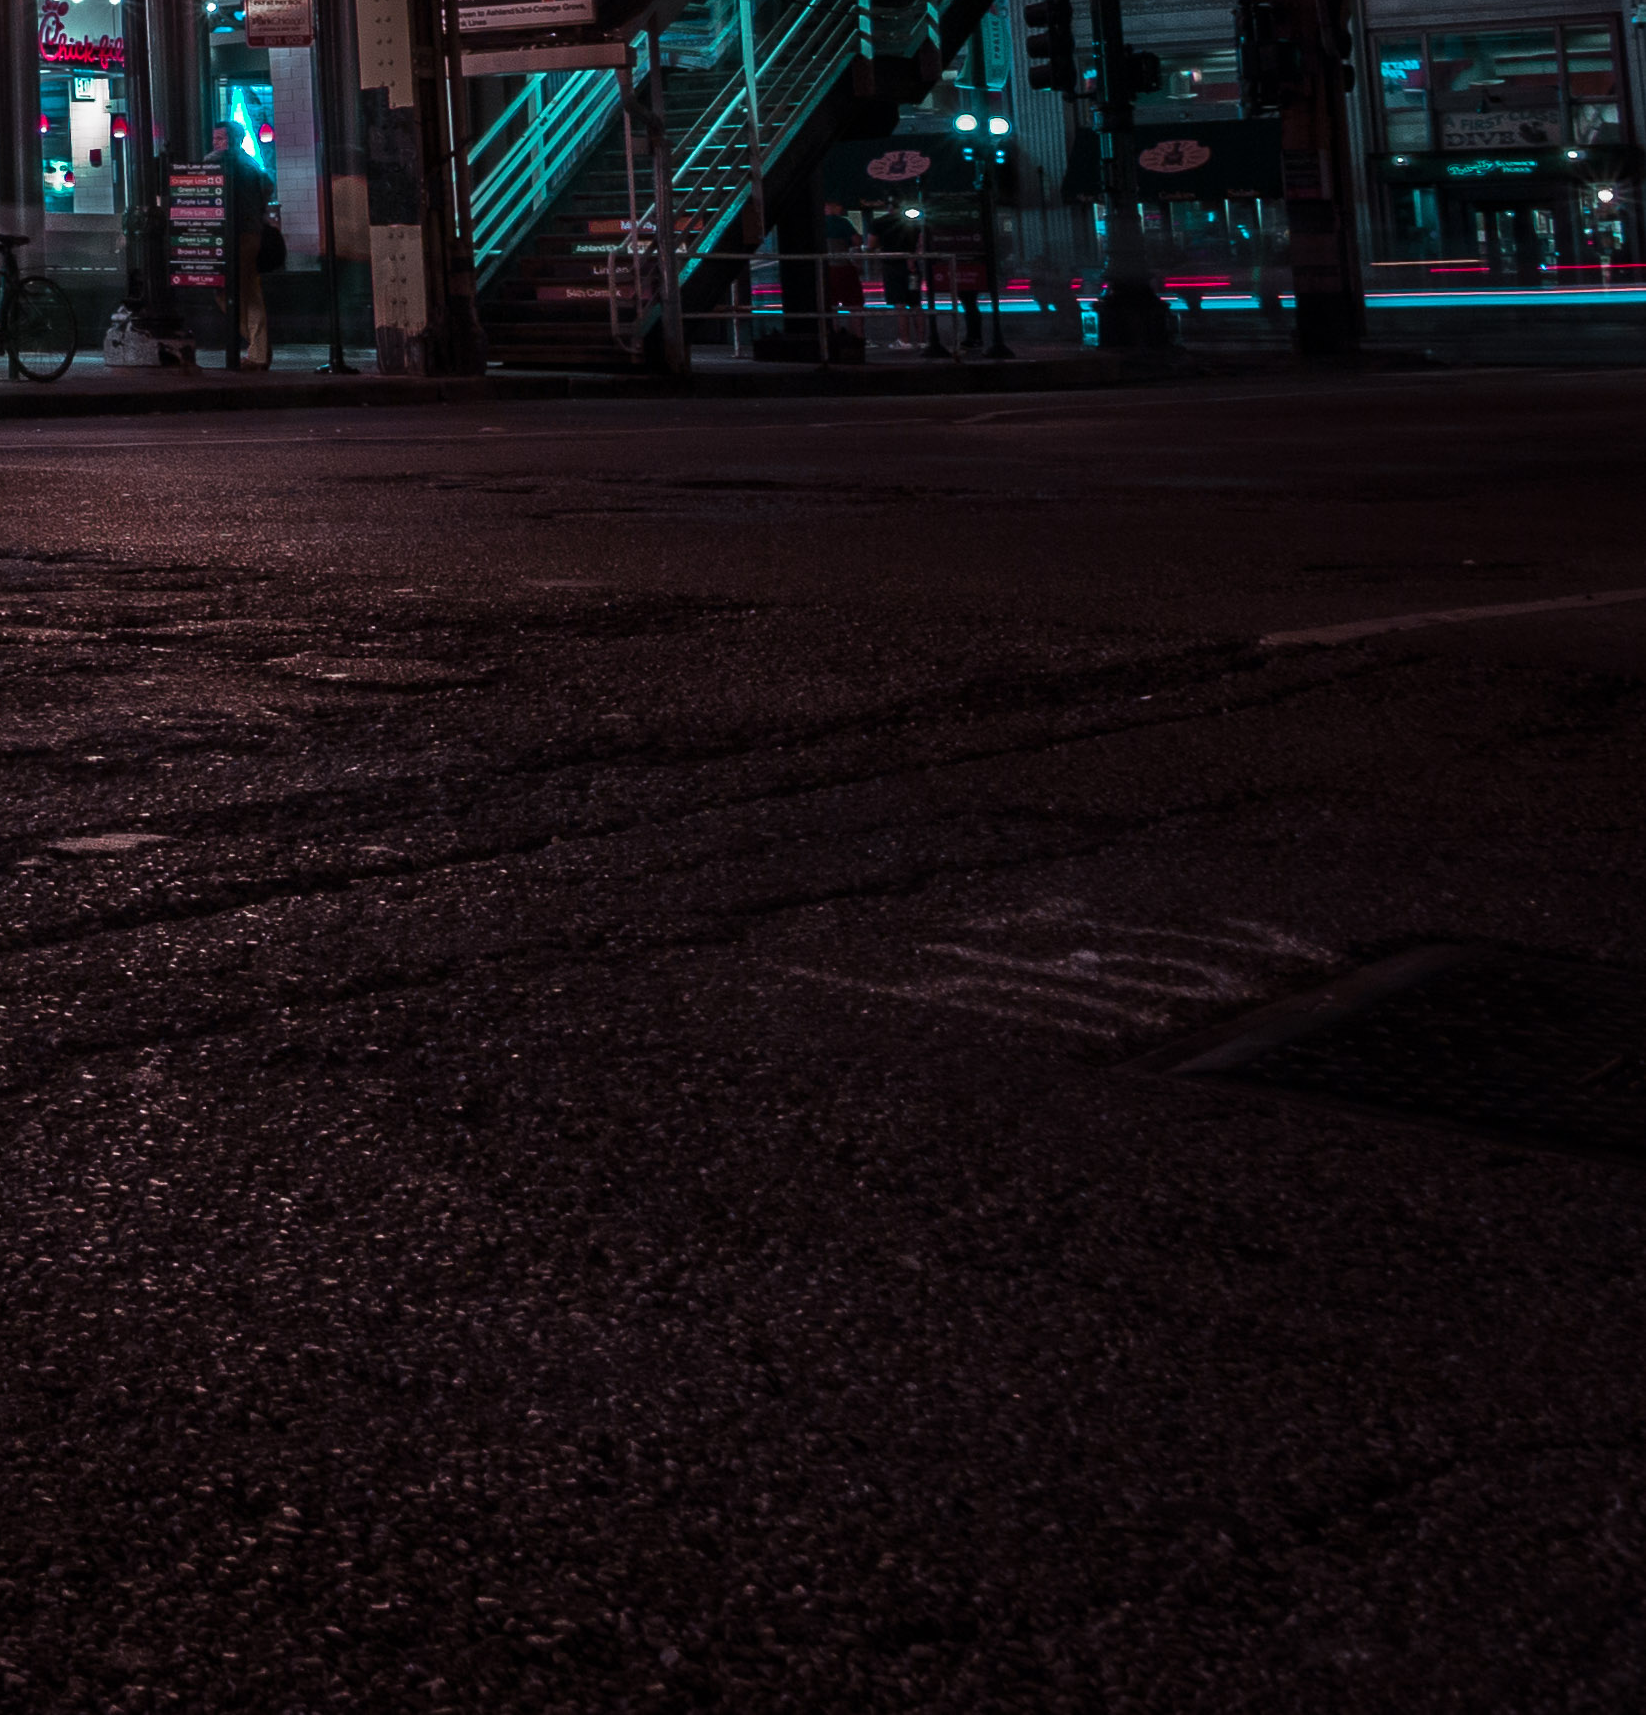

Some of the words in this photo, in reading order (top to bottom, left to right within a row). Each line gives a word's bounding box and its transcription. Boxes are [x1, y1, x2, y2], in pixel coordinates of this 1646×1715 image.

[459, 9, 477, 19] reen
[468, 19, 488, 28] Lines
[38, 11, 126, 70] Chick-fil
[1445, 131, 1517, 147] DIVE
[176, 198, 196, 206] Purple
[593, 265, 630, 276] Linen
